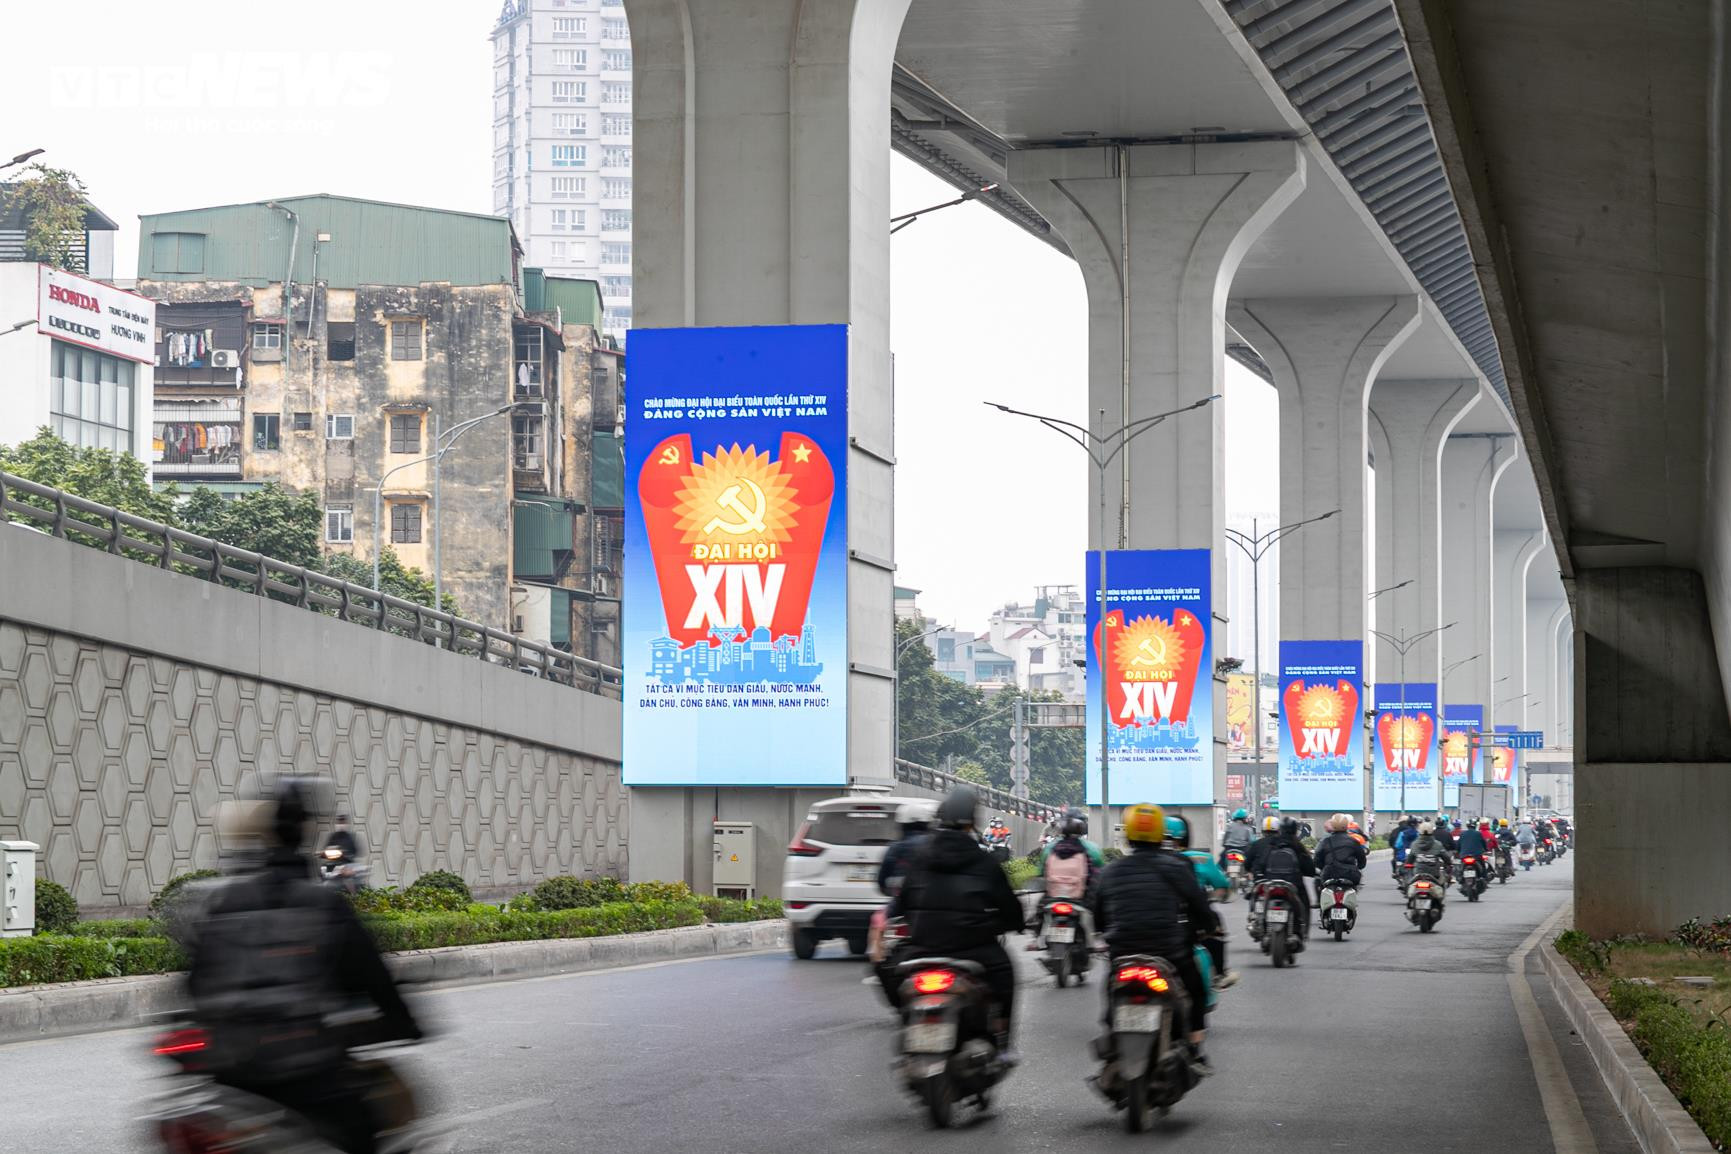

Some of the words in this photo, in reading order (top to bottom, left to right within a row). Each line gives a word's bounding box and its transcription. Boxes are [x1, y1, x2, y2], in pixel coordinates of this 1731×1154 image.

[49, 284, 101, 314] HONDA
[644, 408, 684, 419] ĐẢNG
[688, 408, 726, 420] CỘNG
[730, 407, 758, 417] SẢN
[762, 406, 792, 418] VIỆT
[796, 407, 828, 416] NAM
[694, 544, 730, 562] ĐẠI
[738, 540, 776, 562] HỘI
[683, 564, 786, 629] XIV
[1120, 682, 1178, 718] XIV
[1301, 728, 1340, 752] XIV
